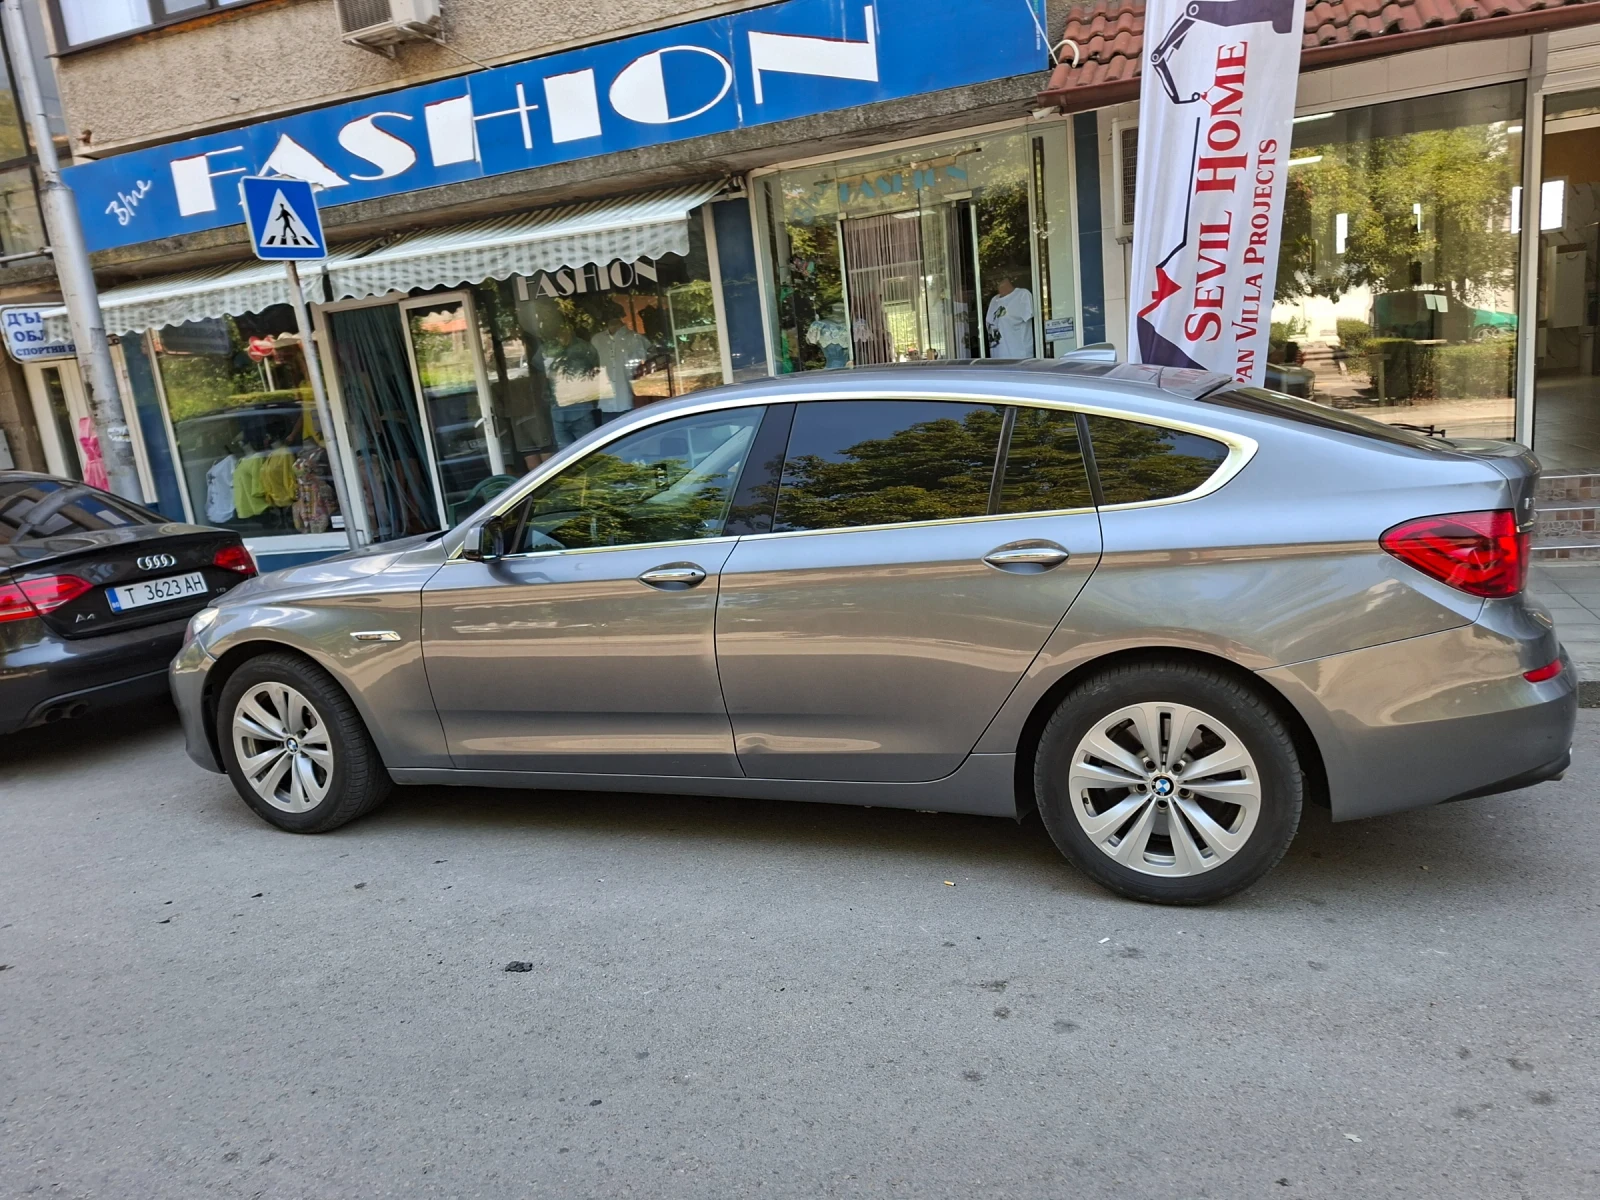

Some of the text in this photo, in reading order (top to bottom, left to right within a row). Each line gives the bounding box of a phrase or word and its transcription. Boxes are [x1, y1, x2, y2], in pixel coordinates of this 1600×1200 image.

[170, 5, 879, 217] FASHION
[1184, 41, 1248, 342] SEVIL HOME
[1243, 138, 1278, 265] PROJECTS
[516, 260, 658, 302] FASHION
[1231, 272, 1263, 342] VILLA
[75, 612, 97, 623] A4
[124, 587, 136, 605] T
[144, 579, 182, 601] 3623
[184, 574, 205, 593] AH
